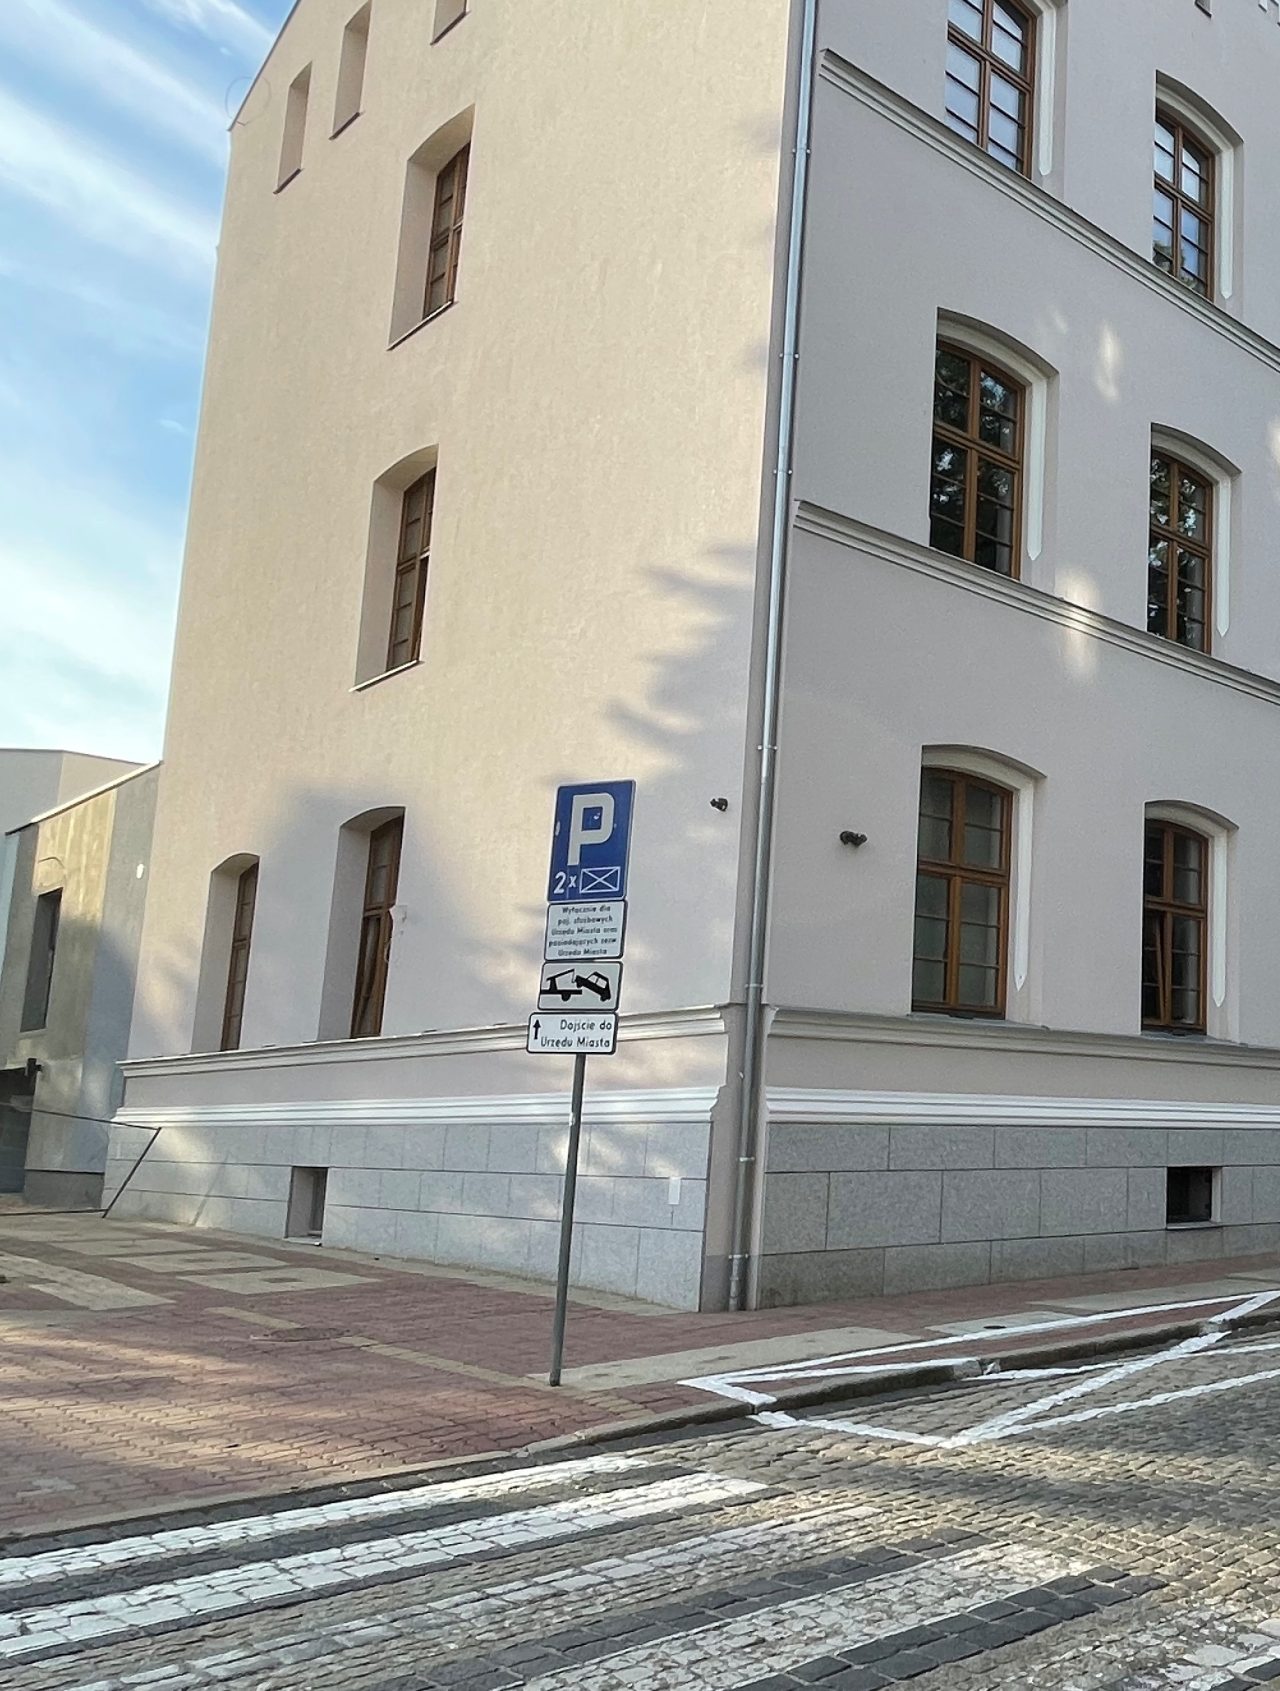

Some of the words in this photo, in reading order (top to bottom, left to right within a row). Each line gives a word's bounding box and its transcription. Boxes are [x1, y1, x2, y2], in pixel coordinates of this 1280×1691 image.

[567, 793, 615, 865] P
[599, 1020, 612, 1030] do
[576, 1037, 611, 1048] Miasta
